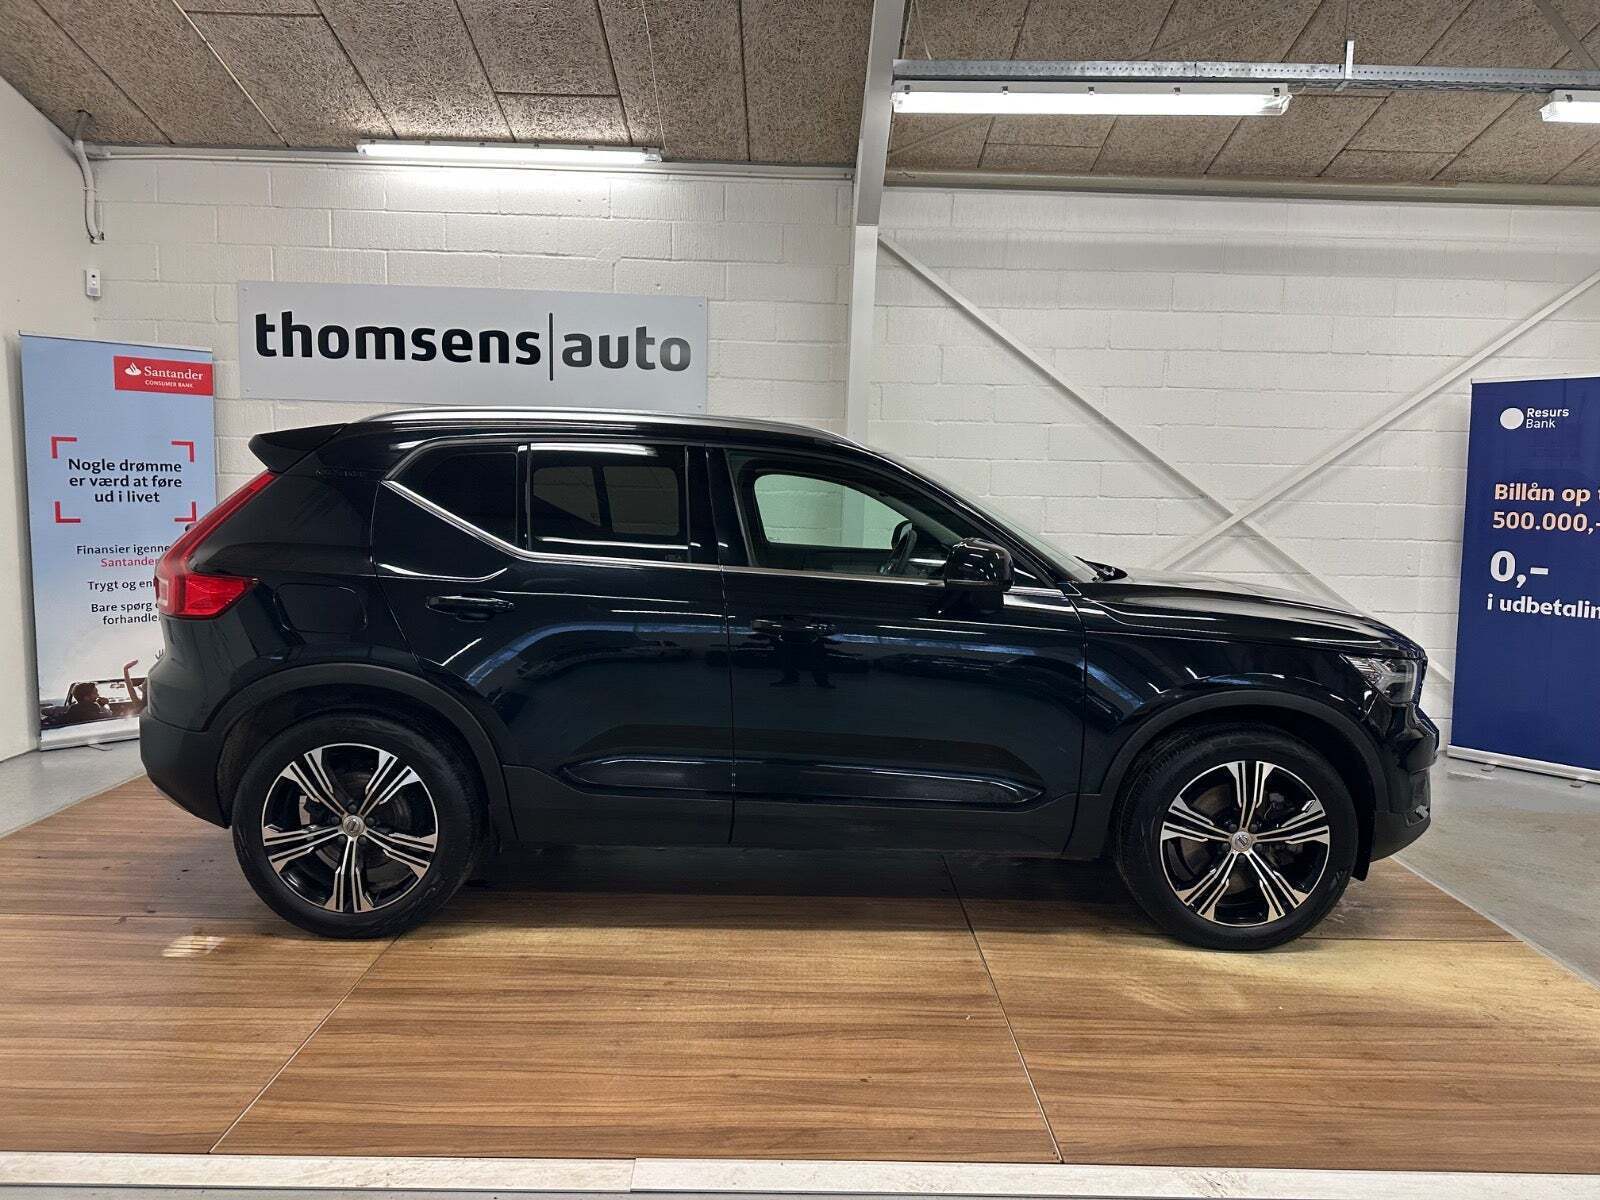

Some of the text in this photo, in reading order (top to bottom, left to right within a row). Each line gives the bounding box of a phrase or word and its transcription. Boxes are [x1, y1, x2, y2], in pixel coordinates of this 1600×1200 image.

[143, 365, 204, 380] Santander
[144, 379, 177, 388] CONSUMER
[1526, 407, 1570, 417] Resurs
[1526, 418, 1556, 429] Bank
[68, 458, 182, 474] Nogle drømme
[69, 475, 182, 488] er værd at føre
[94, 490, 160, 503] ud i livet
[1494, 482, 1554, 502] Billån
[1562, 488, 1591, 507] op
[76, 544, 170, 556] Finansier igenne
[1490, 550, 1549, 589] 0,-
[88, 580, 153, 592] Trygt og en
[91, 603, 118, 613] Bare
[120, 602, 153, 613] spørg
[1486, 593, 1600, 619] i udbetalin
